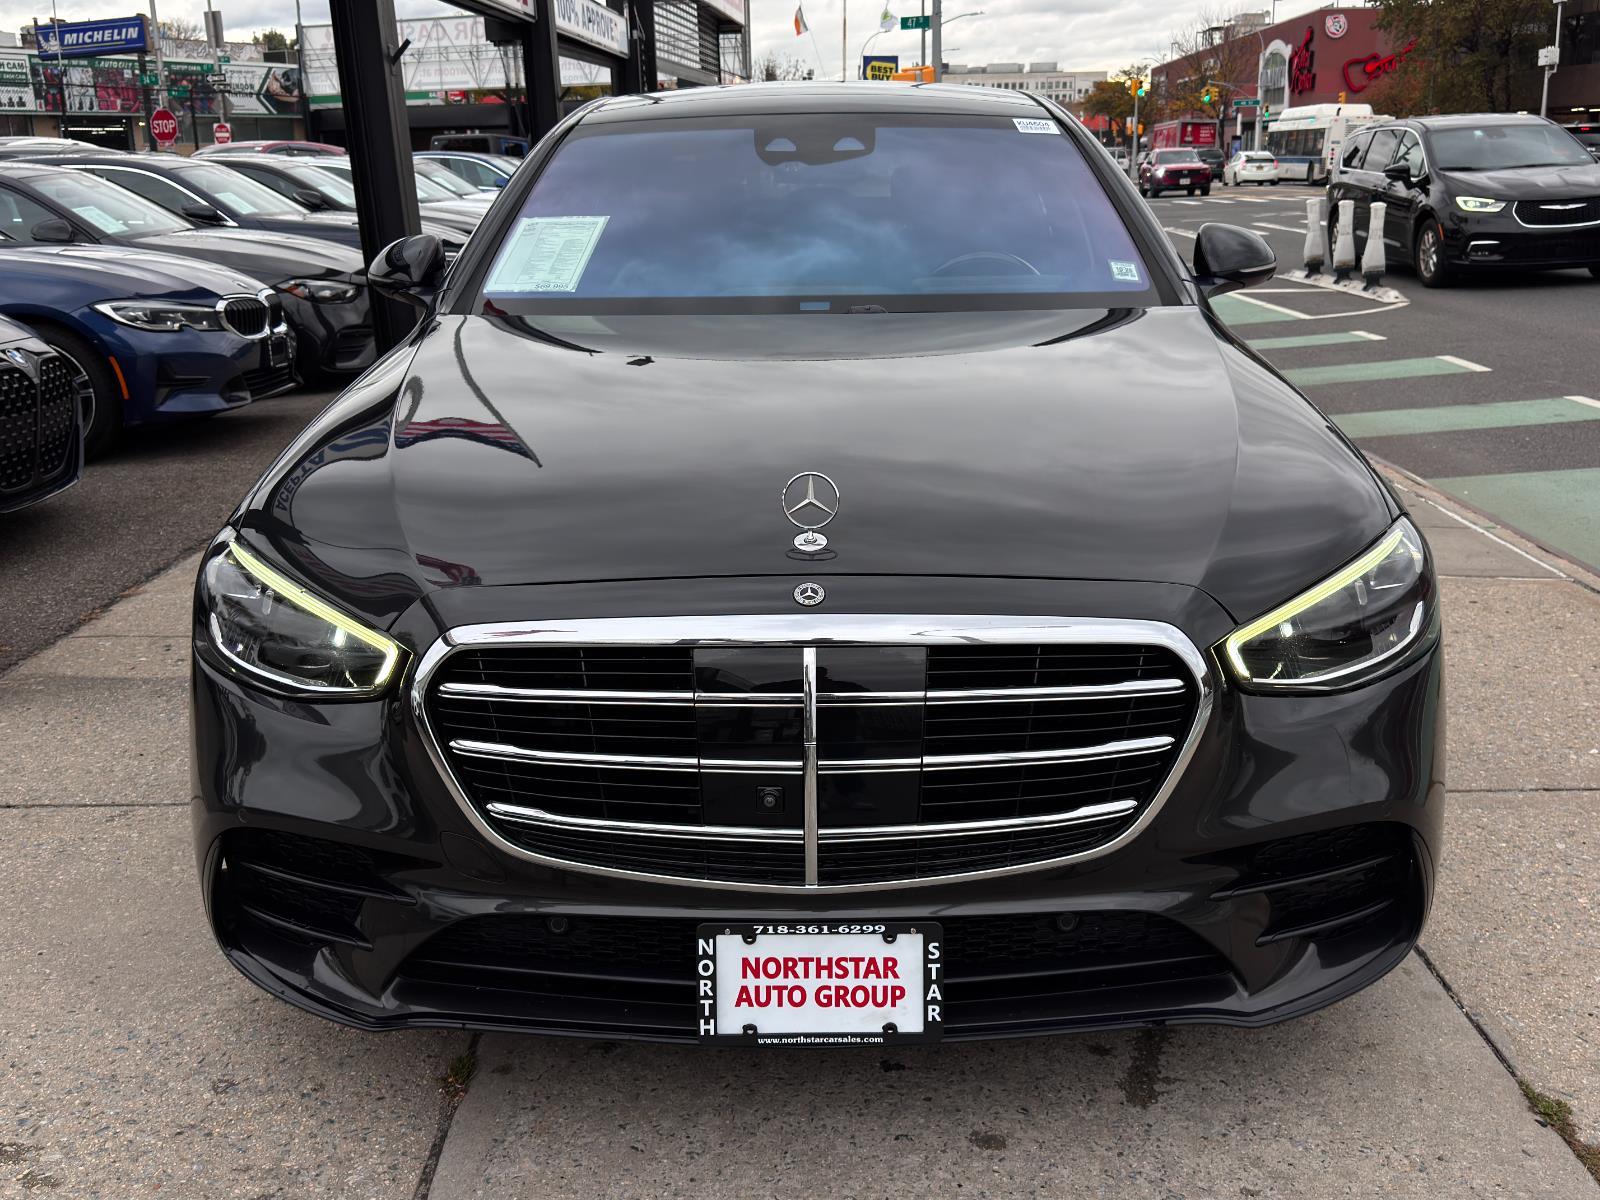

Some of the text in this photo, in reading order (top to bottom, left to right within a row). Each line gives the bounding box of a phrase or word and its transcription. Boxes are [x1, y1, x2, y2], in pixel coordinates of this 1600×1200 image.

[582, 3, 618, 42] APPROVE
[907, 18, 917, 28] 47
[64, 27, 139, 46] MICHELIN
[870, 65, 894, 73] BEST
[871, 73, 892, 81] BUY
[152, 119, 176, 134] STOP
[752, 924, 887, 935] 718-361-6299
[741, 956, 900, 980] NORTHSTAR
[697, 938, 715, 1037] NORTH
[926, 942, 942, 1023] STAR
[734, 984, 906, 1009] AUTO GROUP
[757, 1035, 884, 1045] www.northstarcarsales.com
